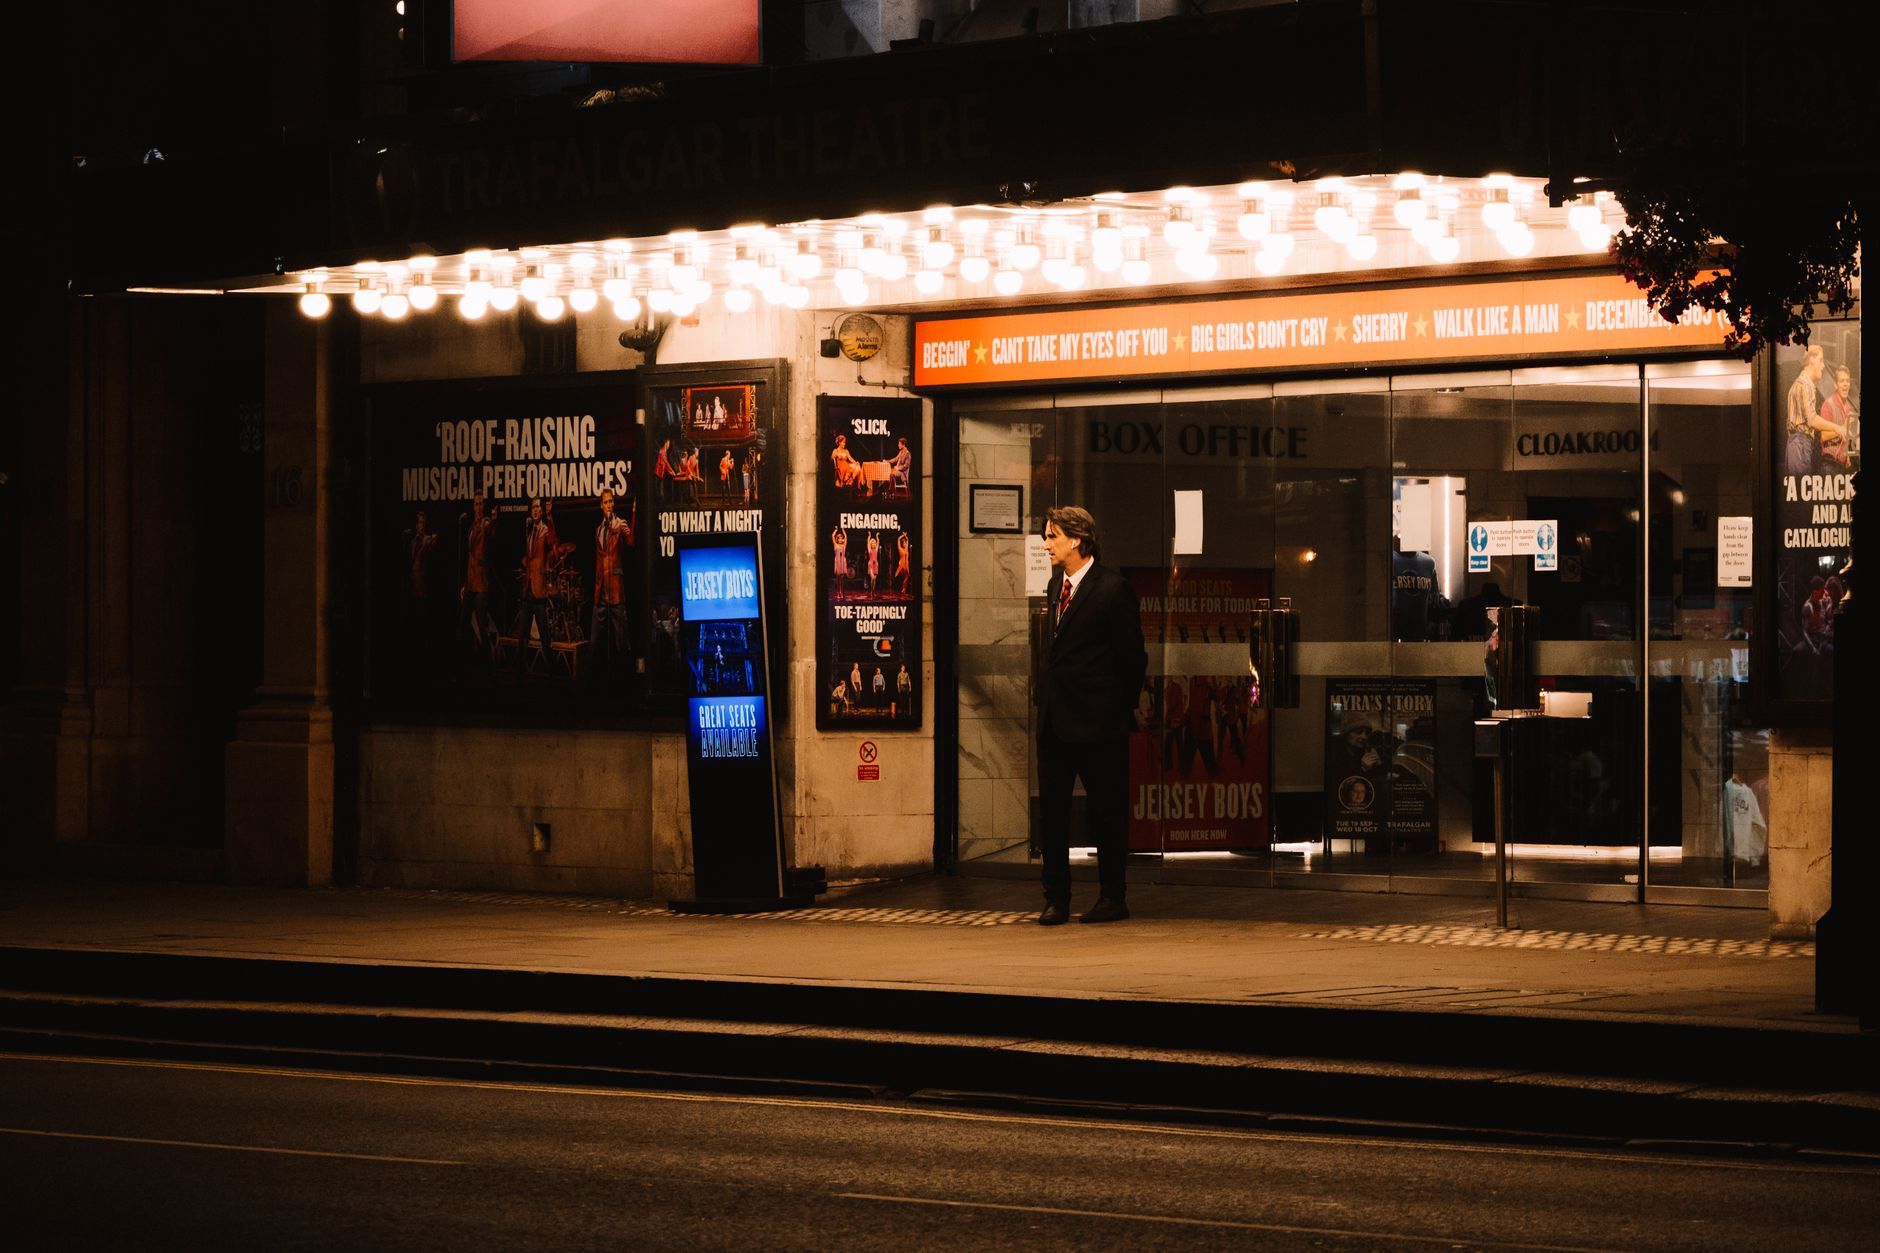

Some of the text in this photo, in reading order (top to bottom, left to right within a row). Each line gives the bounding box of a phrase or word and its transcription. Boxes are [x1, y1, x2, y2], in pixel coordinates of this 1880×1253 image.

[431, 94, 993, 214] TRAFALGAR THEATRE
[923, 340, 971, 369] BEGGIN'
[992, 337, 1024, 365] CANT
[1026, 334, 1057, 362] TAKE
[1059, 333, 1079, 361] MY
[1082, 331, 1114, 359] EYES
[1116, 329, 1139, 358] OFF
[1142, 327, 1168, 356] YOU
[1191, 324, 1214, 353] BIG
[1216, 321, 1255, 351] GIRLS
[1257, 318, 1298, 349] DON'T
[1301, 317, 1328, 347] CRY
[1352, 312, 1408, 344] SHERRY
[1433, 306, 1475, 338] WALK
[1476, 305, 1509, 336] LIKE
[1511, 304, 1520, 334] A
[1524, 303, 1559, 333] MAN
[435, 414, 596, 464] 'ROOF-RAISING
[851, 418, 891, 437] 'SLICK,
[1089, 420, 1308, 459] BOX OFFICE
[271, 465, 304, 507] 16
[402, 459, 632, 501] MUSICAL PERFORMANCES'
[1783, 475, 1798, 502] 'A
[659, 509, 762, 533] 'OH WHAT A NIGHT!
[840, 513, 901, 532] ENGAGING,
[1811, 504, 1838, 524] AND
[684, 569, 754, 601] JERSEY BOYS
[1168, 579, 1233, 596] GOOD SEATS
[834, 605, 907, 620] TOE-TAPPINGLY
[1139, 596, 1258, 613] AVALABLE FOR TODAY
[856, 619, 885, 633] GOOD'
[1330, 694, 1433, 711] MYRA'S STORY
[699, 704, 756, 728] GREAT SEATS
[701, 728, 758, 758] AVAILABLE
[1133, 782, 1263, 820] JERSEY BOYS
[1170, 828, 1228, 841] BOOK HERE NOW
